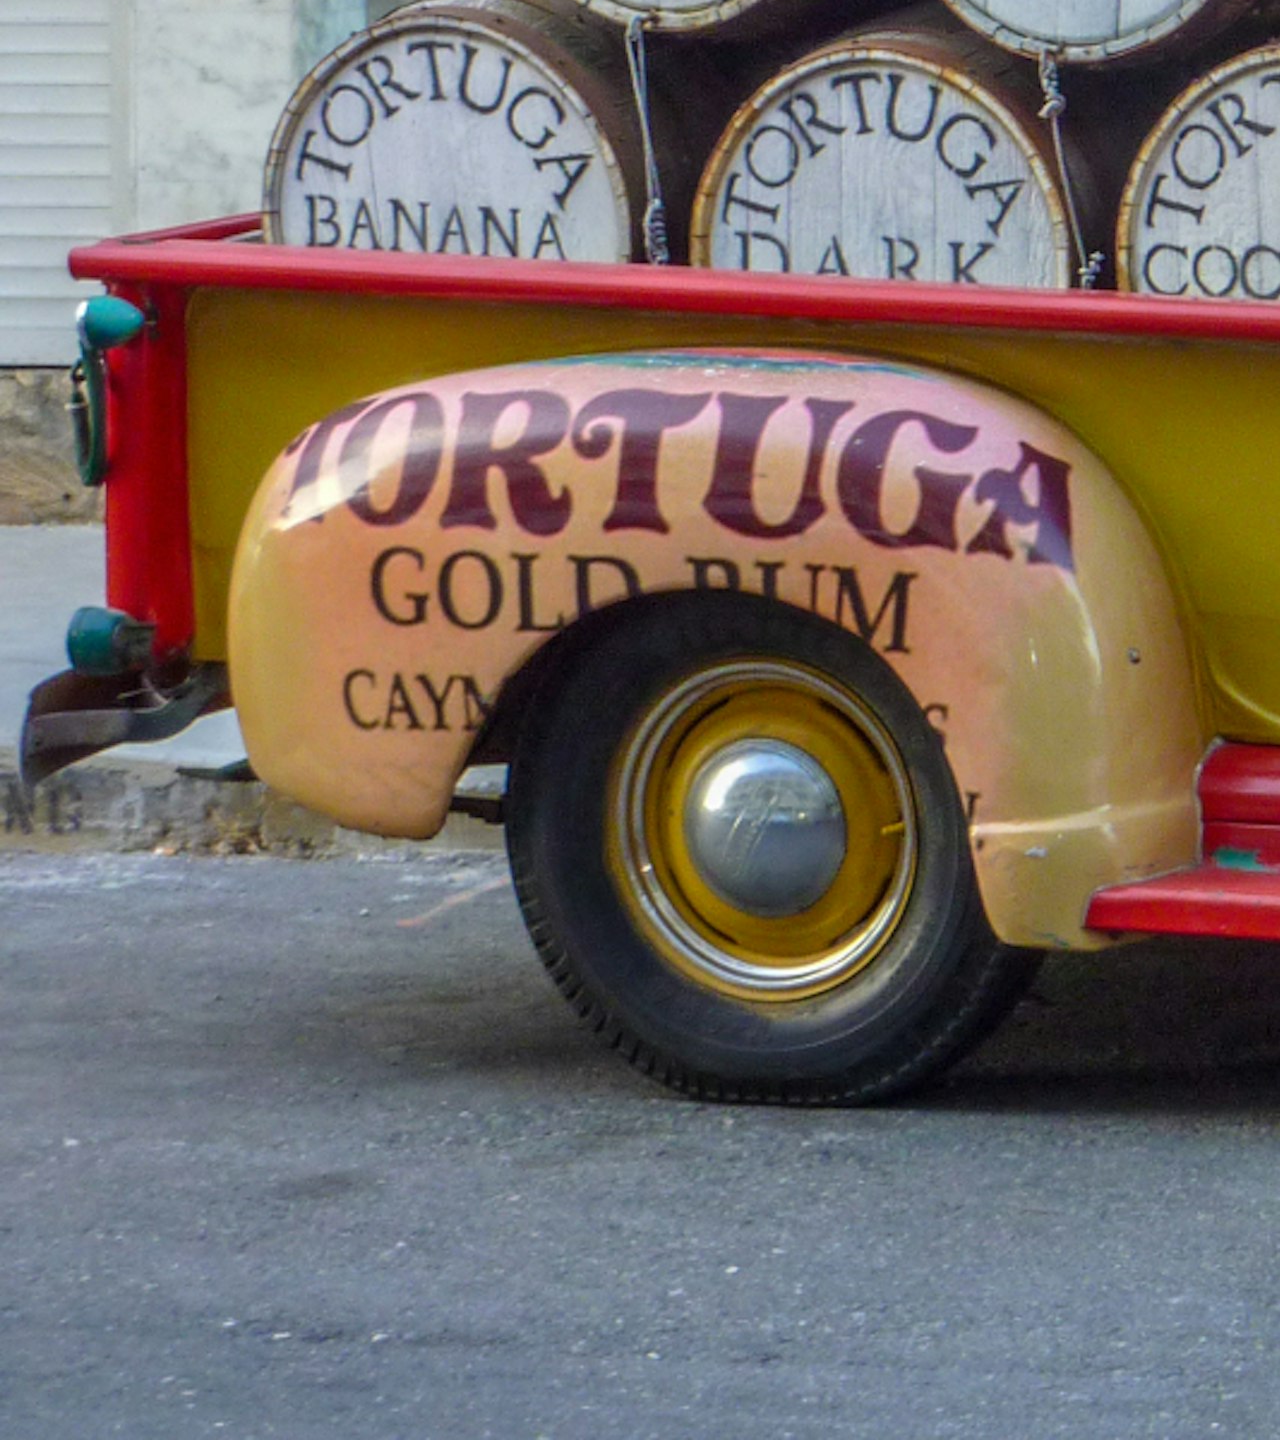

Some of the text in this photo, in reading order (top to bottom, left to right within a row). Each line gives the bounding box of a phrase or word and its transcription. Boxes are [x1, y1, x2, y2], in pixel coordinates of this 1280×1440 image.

[296, 40, 595, 210] TORTUGA
[721, 71, 1027, 237] TORTUGA
[304, 193, 566, 262] BANANA
[734, 230, 996, 284] DARK
[281, 387, 1079, 574] TORTUGA
[369, 546, 642, 632] GOLD
